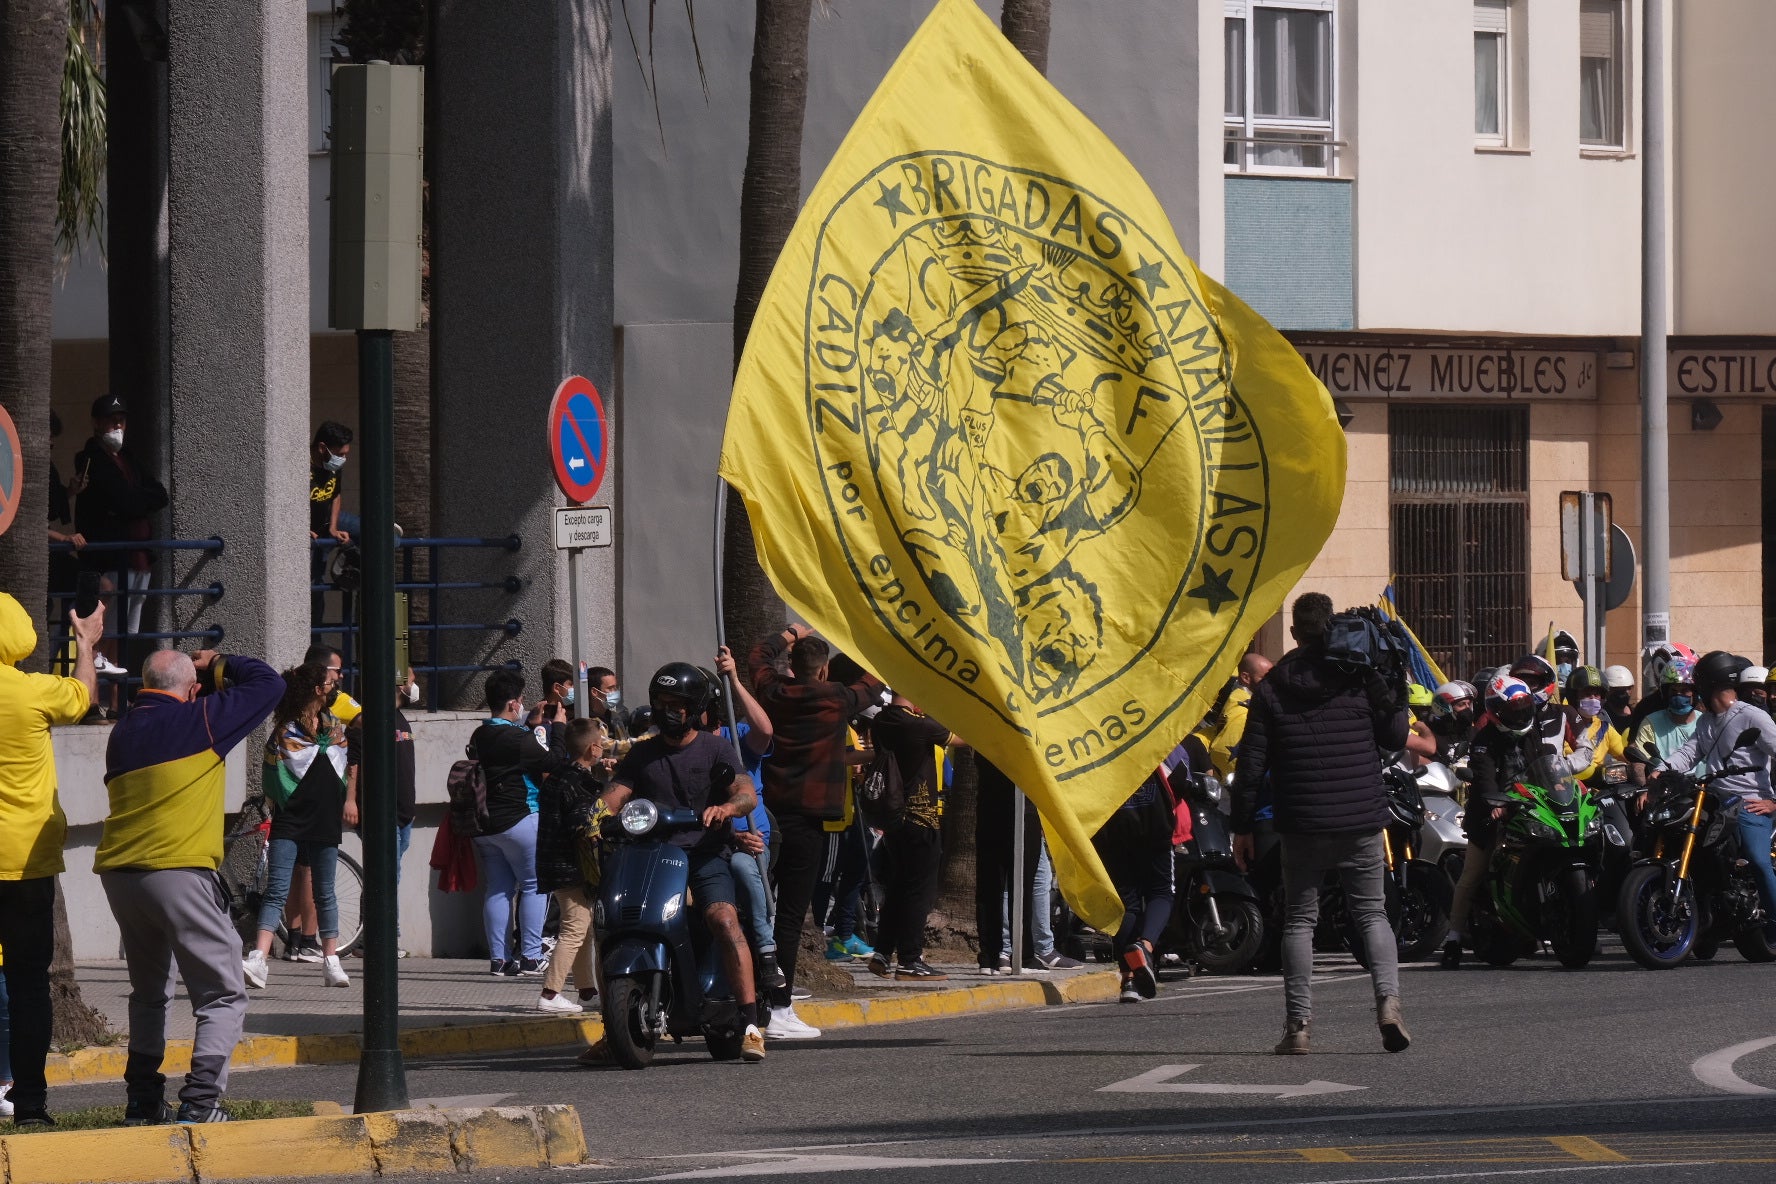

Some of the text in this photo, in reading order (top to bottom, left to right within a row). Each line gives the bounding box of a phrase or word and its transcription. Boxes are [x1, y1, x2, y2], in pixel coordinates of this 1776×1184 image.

[901, 158, 1128, 259] BRIGADAS
[815, 273, 861, 435] CADIZ
[1430, 354, 1567, 394] MUEBLES
[1577, 361, 1593, 389] de
[964, 415, 987, 432] PLUS
[1156, 299, 1262, 559] AMARILLAS
[564, 513, 603, 528] Excepto carga
[827, 461, 867, 521] por
[568, 530, 600, 543] y descarga
[870, 554, 982, 684] encima
[1038, 699, 1147, 767] emas
